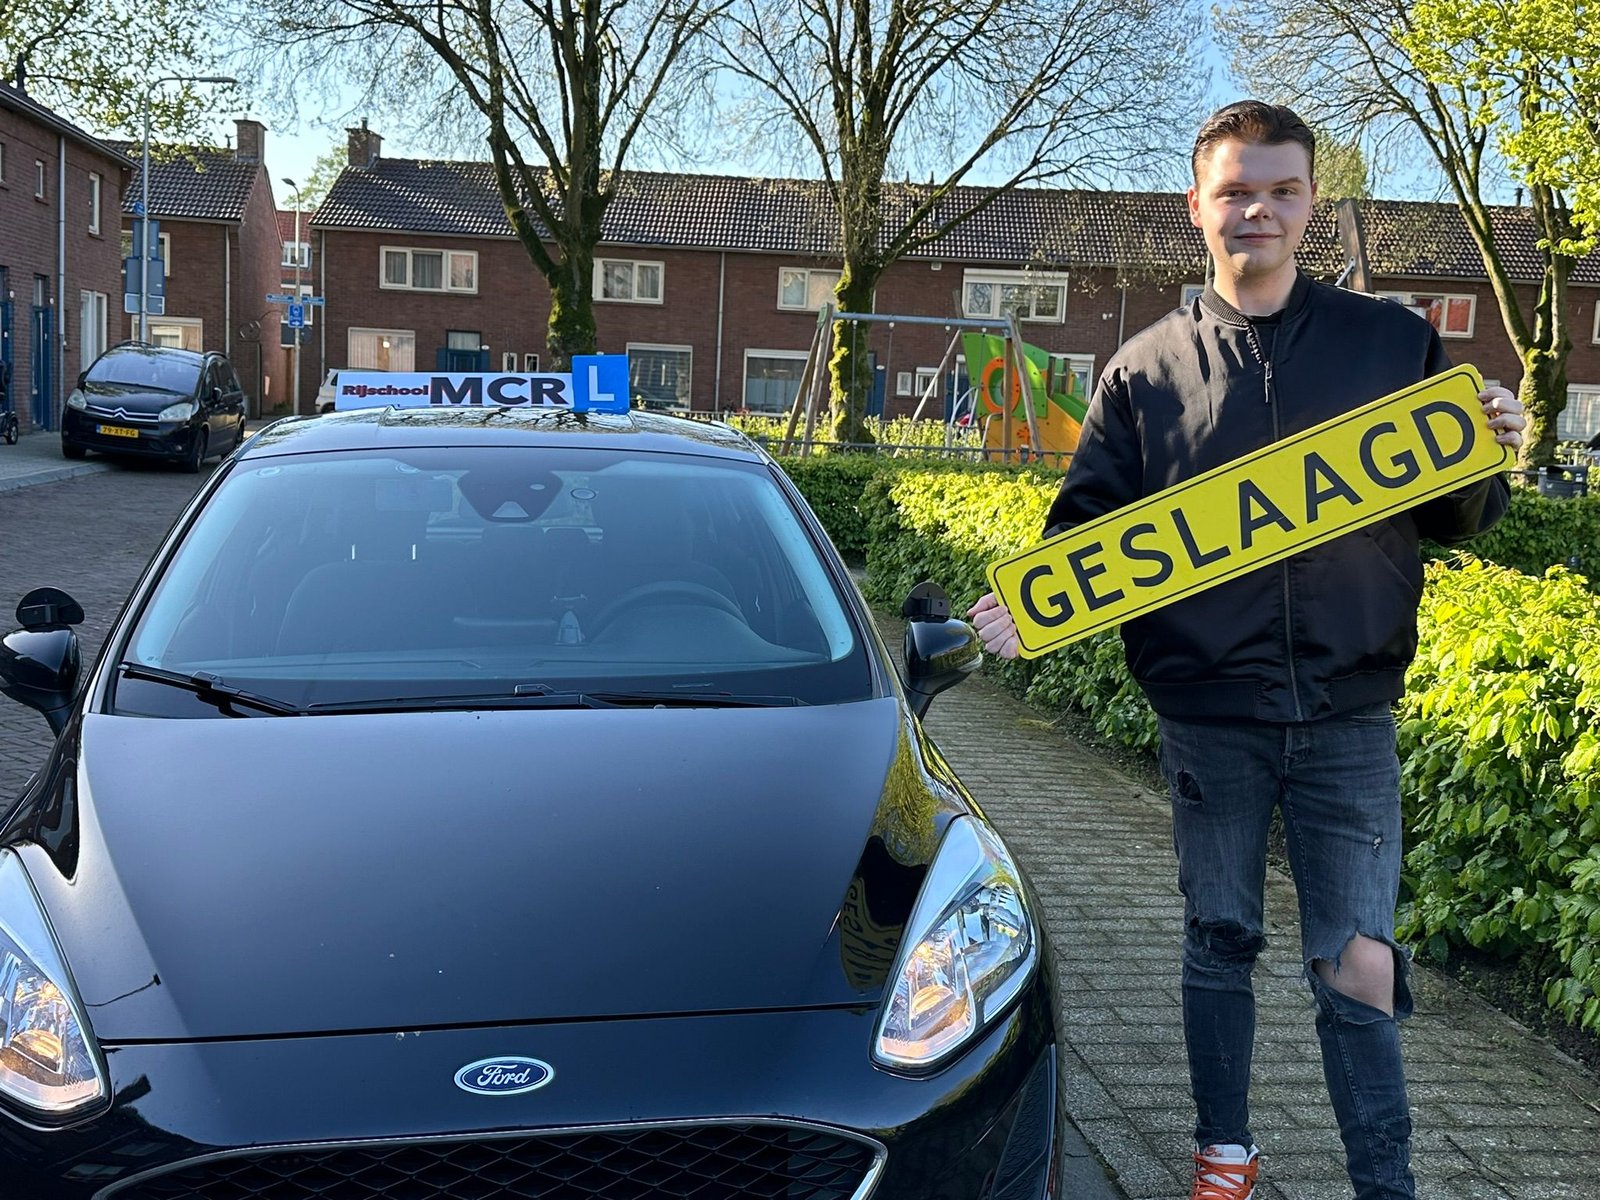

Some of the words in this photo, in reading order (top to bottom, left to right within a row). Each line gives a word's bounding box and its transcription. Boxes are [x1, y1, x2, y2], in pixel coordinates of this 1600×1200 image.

[342, 385, 429, 398] Rijschool
[430, 377, 569, 405] MCR
[588, 365, 615, 401] L
[1019, 400, 1476, 627] GESLAAGD
[477, 1064, 531, 1086] Ford
